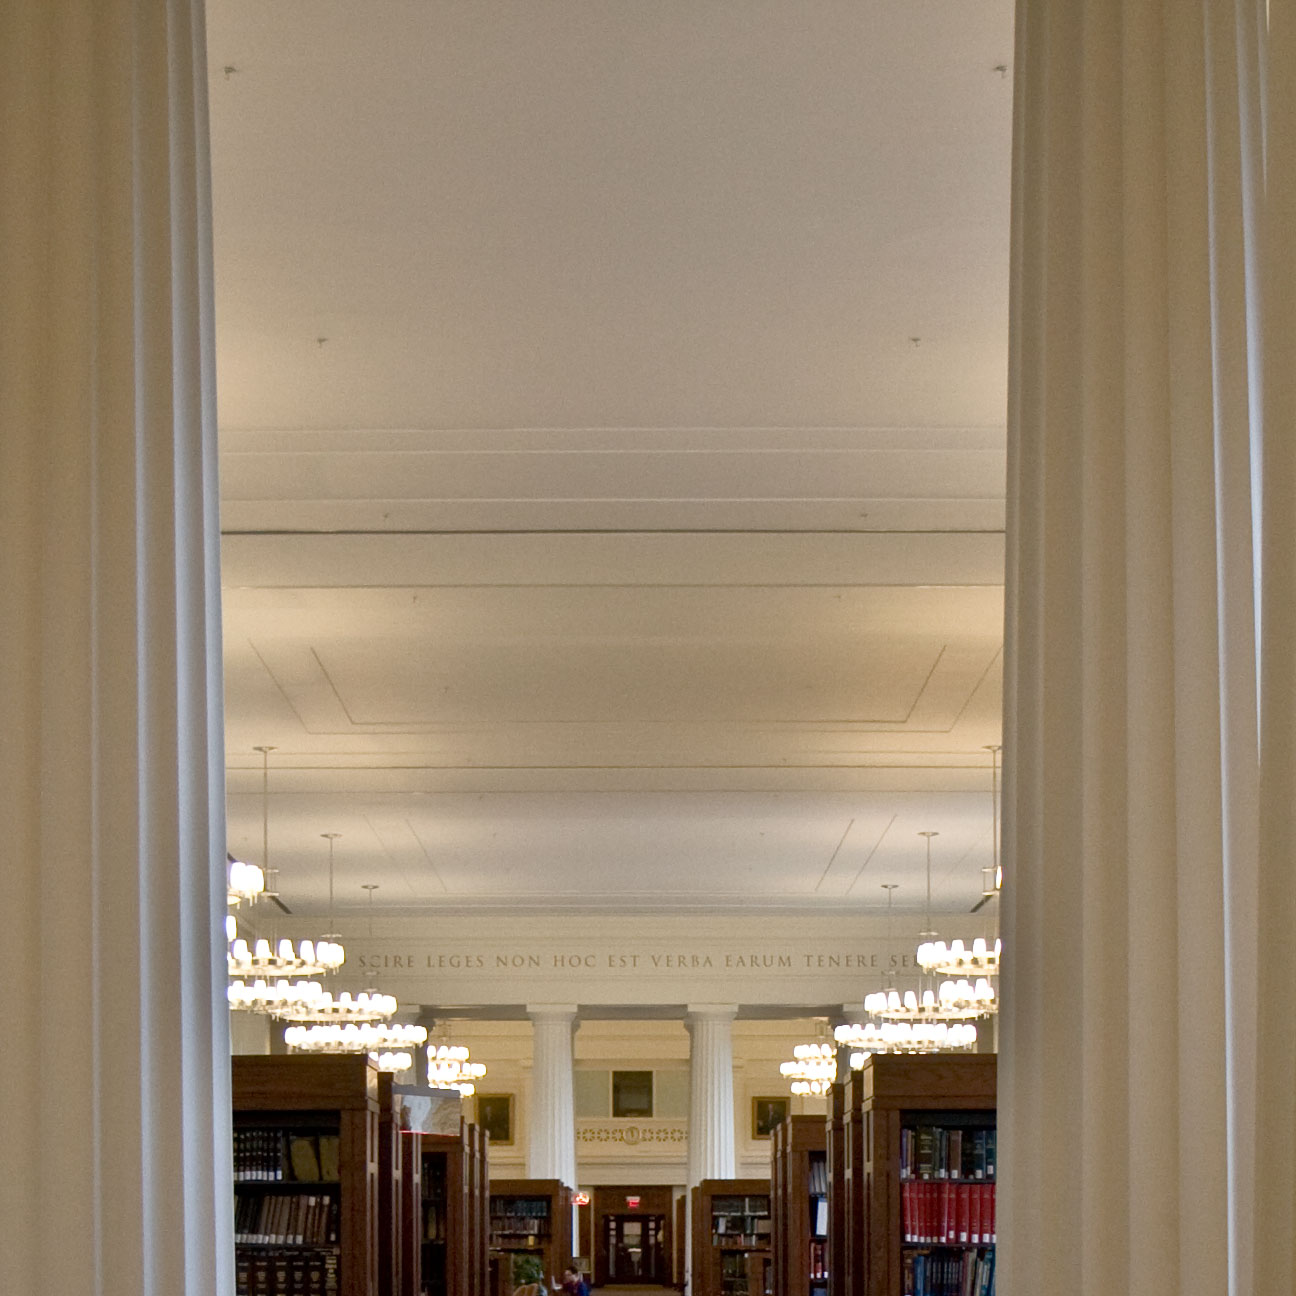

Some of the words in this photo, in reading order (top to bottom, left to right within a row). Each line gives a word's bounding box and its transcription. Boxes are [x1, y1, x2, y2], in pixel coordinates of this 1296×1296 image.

[358, 954, 415, 969] SCIRE
[426, 954, 484, 968] LEGES
[495, 954, 541, 968] NON
[552, 954, 597, 968] HOC
[608, 954, 641, 968] EST
[650, 954, 714, 968] VERBA
[724, 954, 792, 968] EARUM
[805, 954, 878, 968] TENERE
